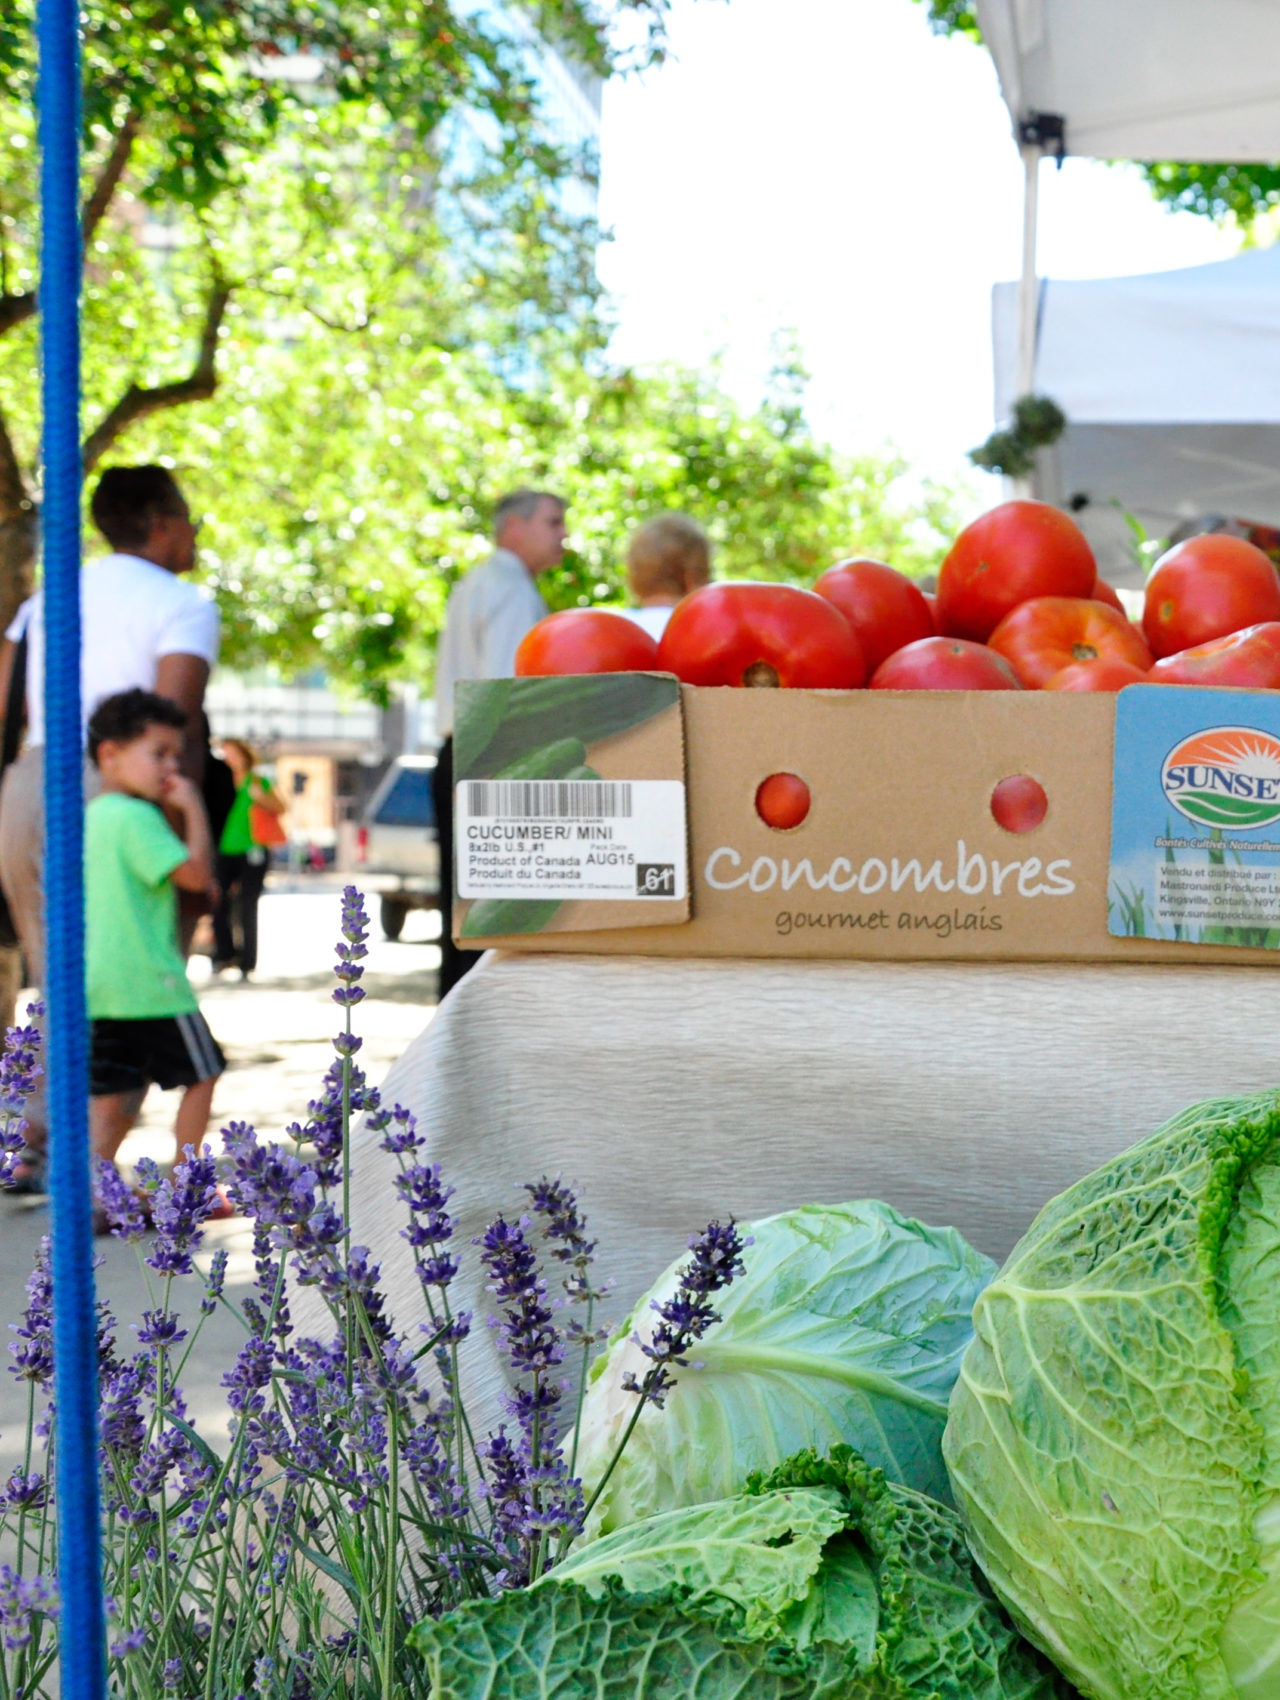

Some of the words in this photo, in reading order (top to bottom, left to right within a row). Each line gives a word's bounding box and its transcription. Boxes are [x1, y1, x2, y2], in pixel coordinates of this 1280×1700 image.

[467, 826, 571, 840] CUCUMBER/
[577, 826, 613, 840] MINI
[469, 856, 516, 866] Product
[521, 856, 532, 866] of
[535, 856, 580, 866] Canada
[586, 854, 634, 865] AUG15
[469, 869, 513, 879] Produit
[517, 869, 531, 879] du
[535, 869, 581, 879] Canada
[704, 839, 1076, 897] Concombres
[1161, 867, 1192, 877] Vendu
[1195, 869, 1204, 877] et
[1208, 869, 1251, 878] distribué
[1160, 881, 1221, 892] Mastronardi
[1224, 884, 1266, 893] Produce
[1159, 895, 1211, 906] Kingsville,
[1214, 897, 1251, 906] Ontario
[1254, 898, 1275, 907] N9Y
[775, 908, 889, 935] gourmet
[897, 907, 1003, 938] anglais
